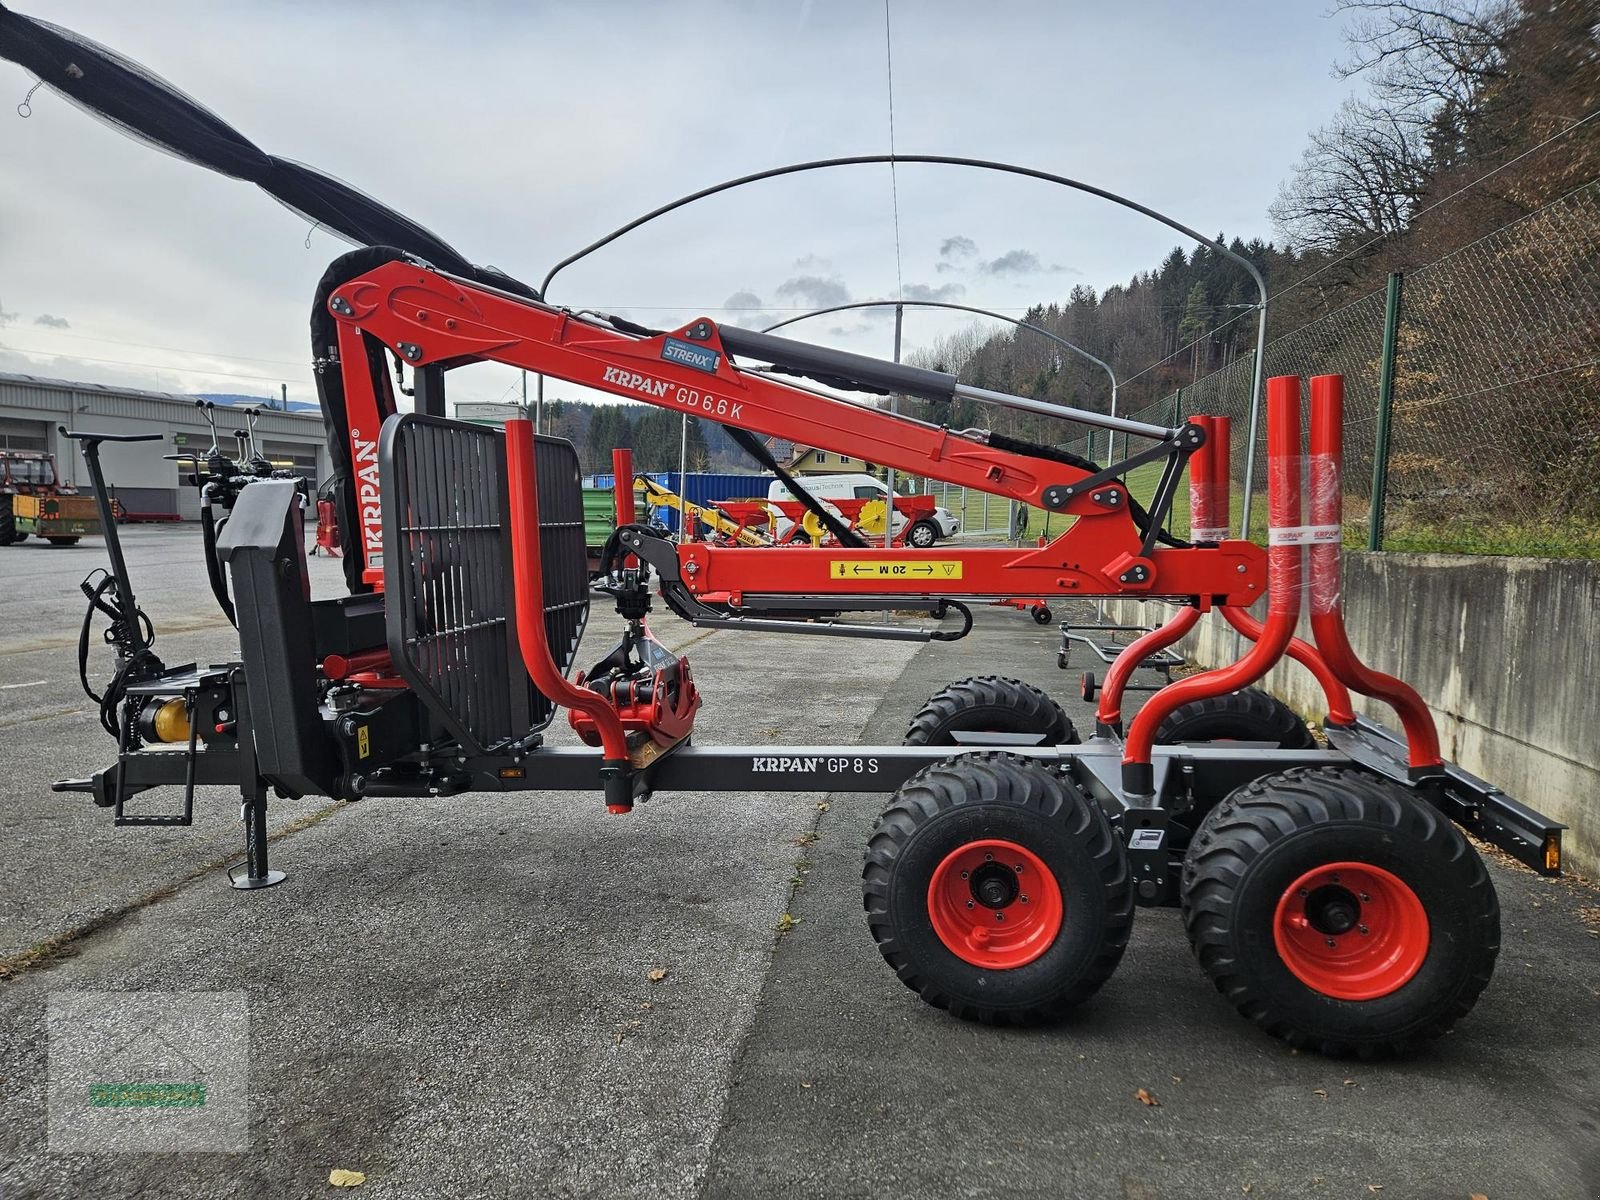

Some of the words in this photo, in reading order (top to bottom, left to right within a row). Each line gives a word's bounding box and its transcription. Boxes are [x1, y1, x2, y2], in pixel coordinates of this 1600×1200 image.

[665, 346, 709, 367] STRENX
[676, 387, 698, 407] GD
[702, 395, 728, 415] 6,6
[730, 403, 744, 419] K
[879, 565, 889, 574] M
[892, 565, 906, 574] 20
[827, 758, 849, 773] GP
[853, 758, 863, 773] 8
[868, 758, 879, 773] S
